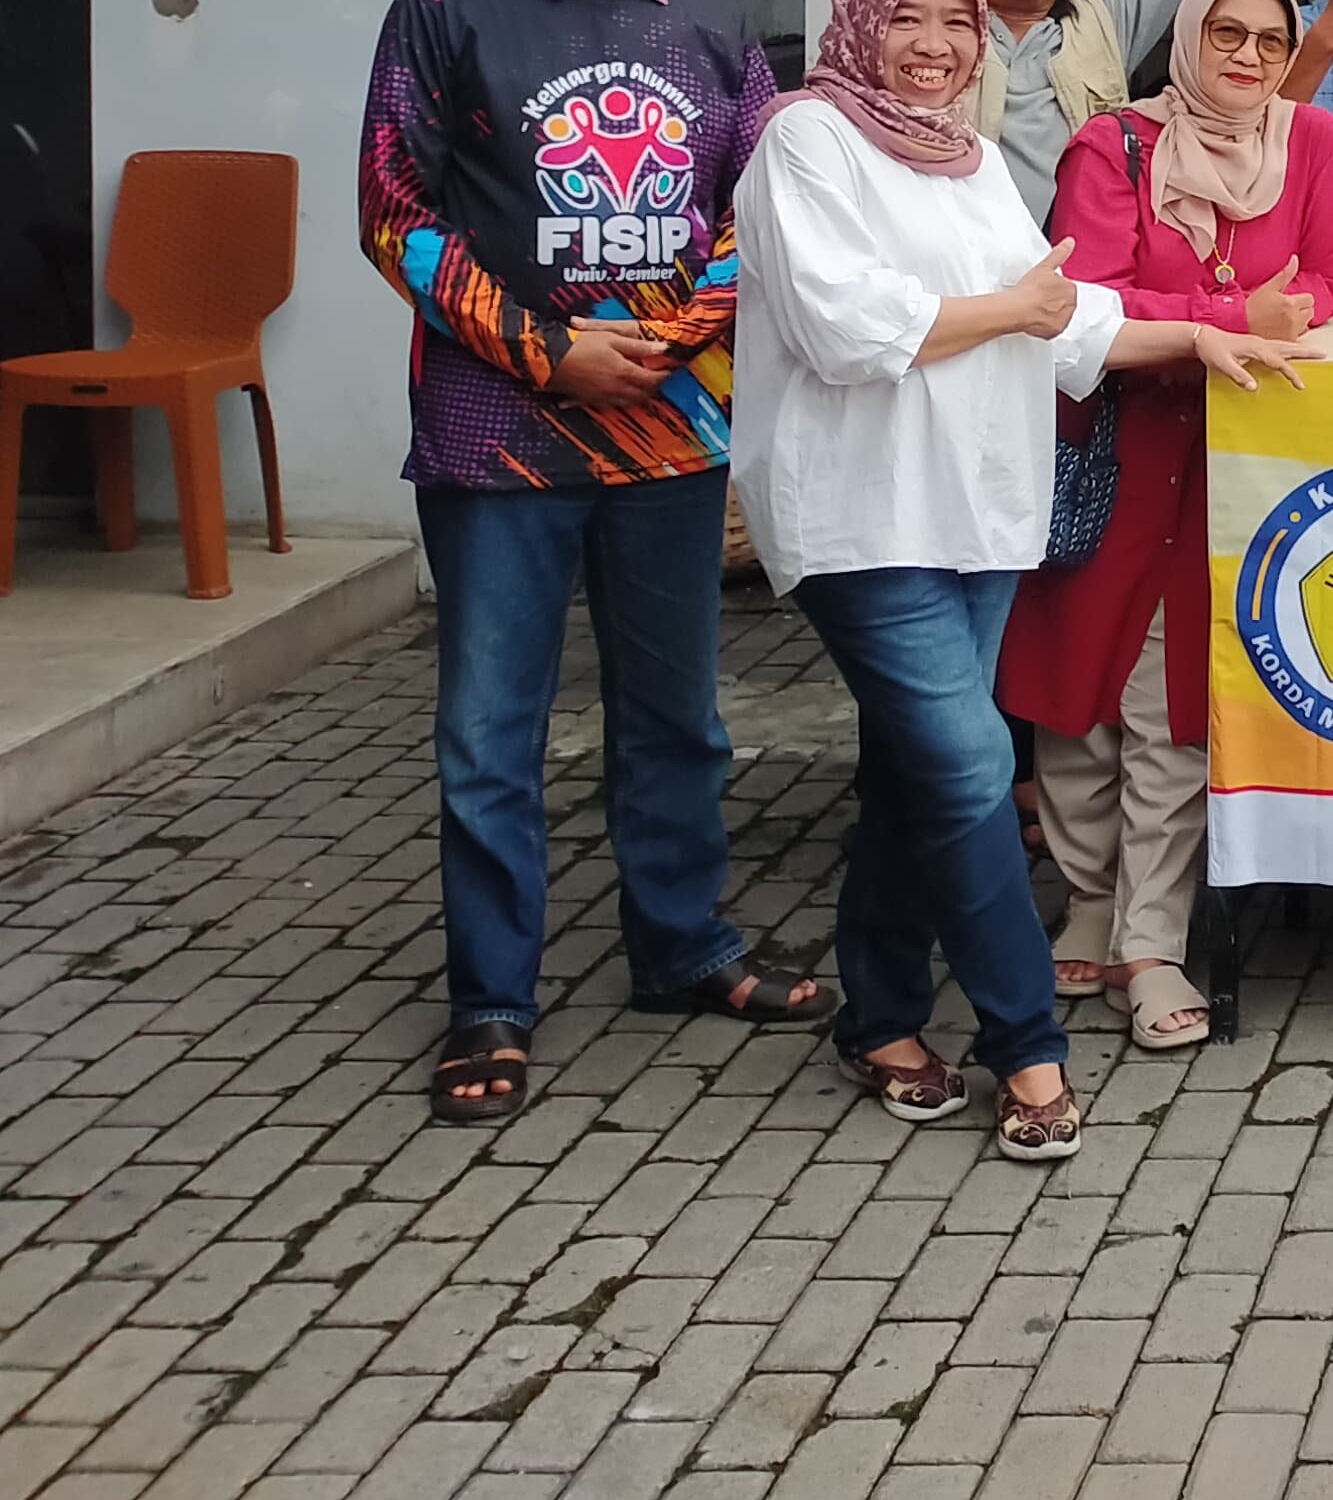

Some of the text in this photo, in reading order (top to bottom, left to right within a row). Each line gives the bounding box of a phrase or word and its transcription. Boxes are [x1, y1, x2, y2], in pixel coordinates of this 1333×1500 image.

[521, 62, 703, 121] Keluarga Alumni
[536, 215, 692, 266] FISIP
[563, 266, 676, 282] Univ. Jember
[1251, 635, 1314, 717] KORDA
